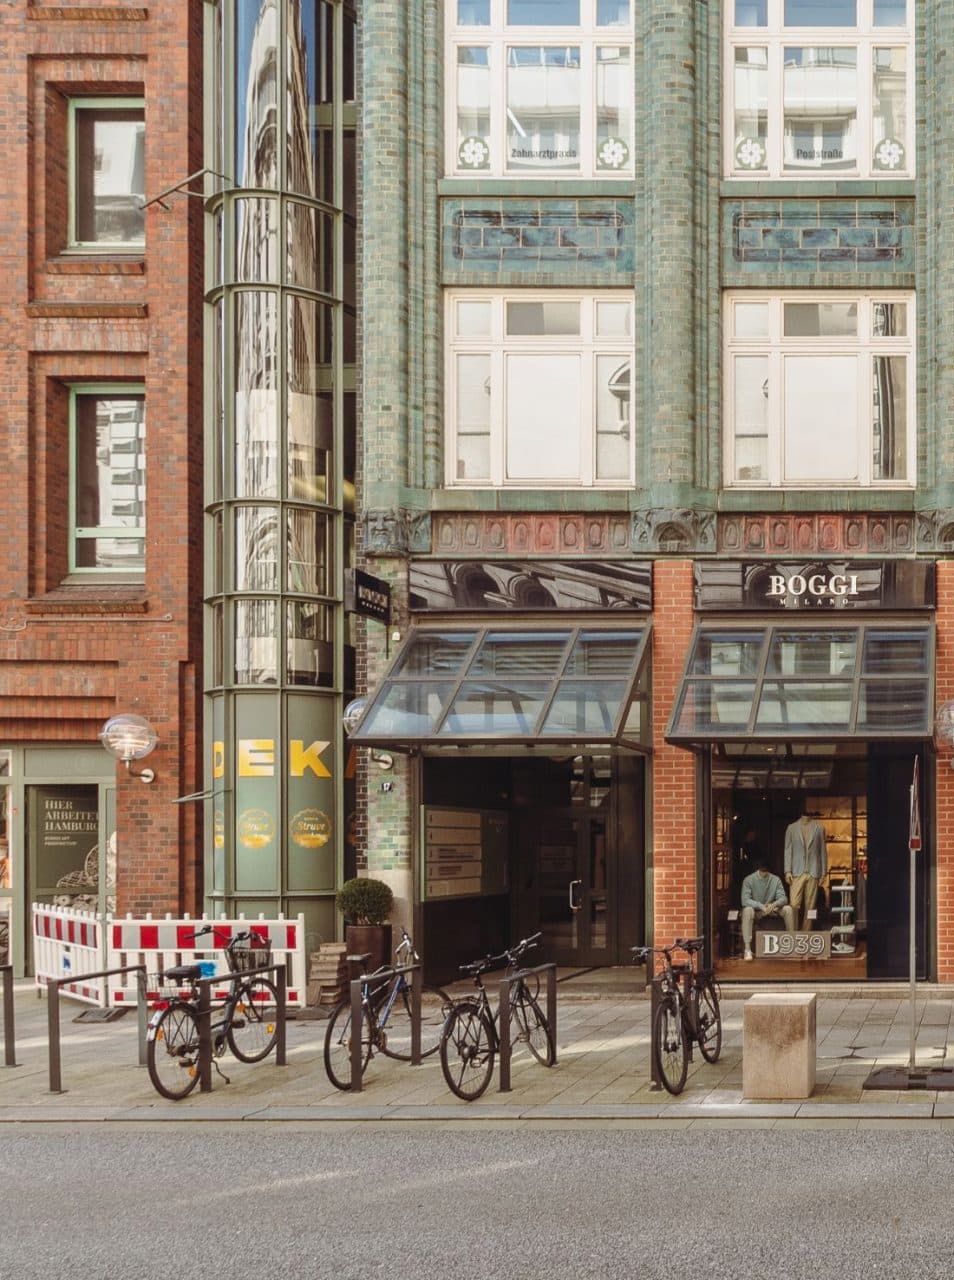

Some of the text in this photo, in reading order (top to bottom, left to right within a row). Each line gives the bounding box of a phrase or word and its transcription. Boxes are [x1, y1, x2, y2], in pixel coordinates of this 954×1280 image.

[511, 148, 577, 160] Zahnarztpraxis
[796, 148, 843, 160] Poststraße
[769, 574, 859, 595] BOGGI
[45, 800, 73, 809] HIER
[763, 934, 825, 955] B939
